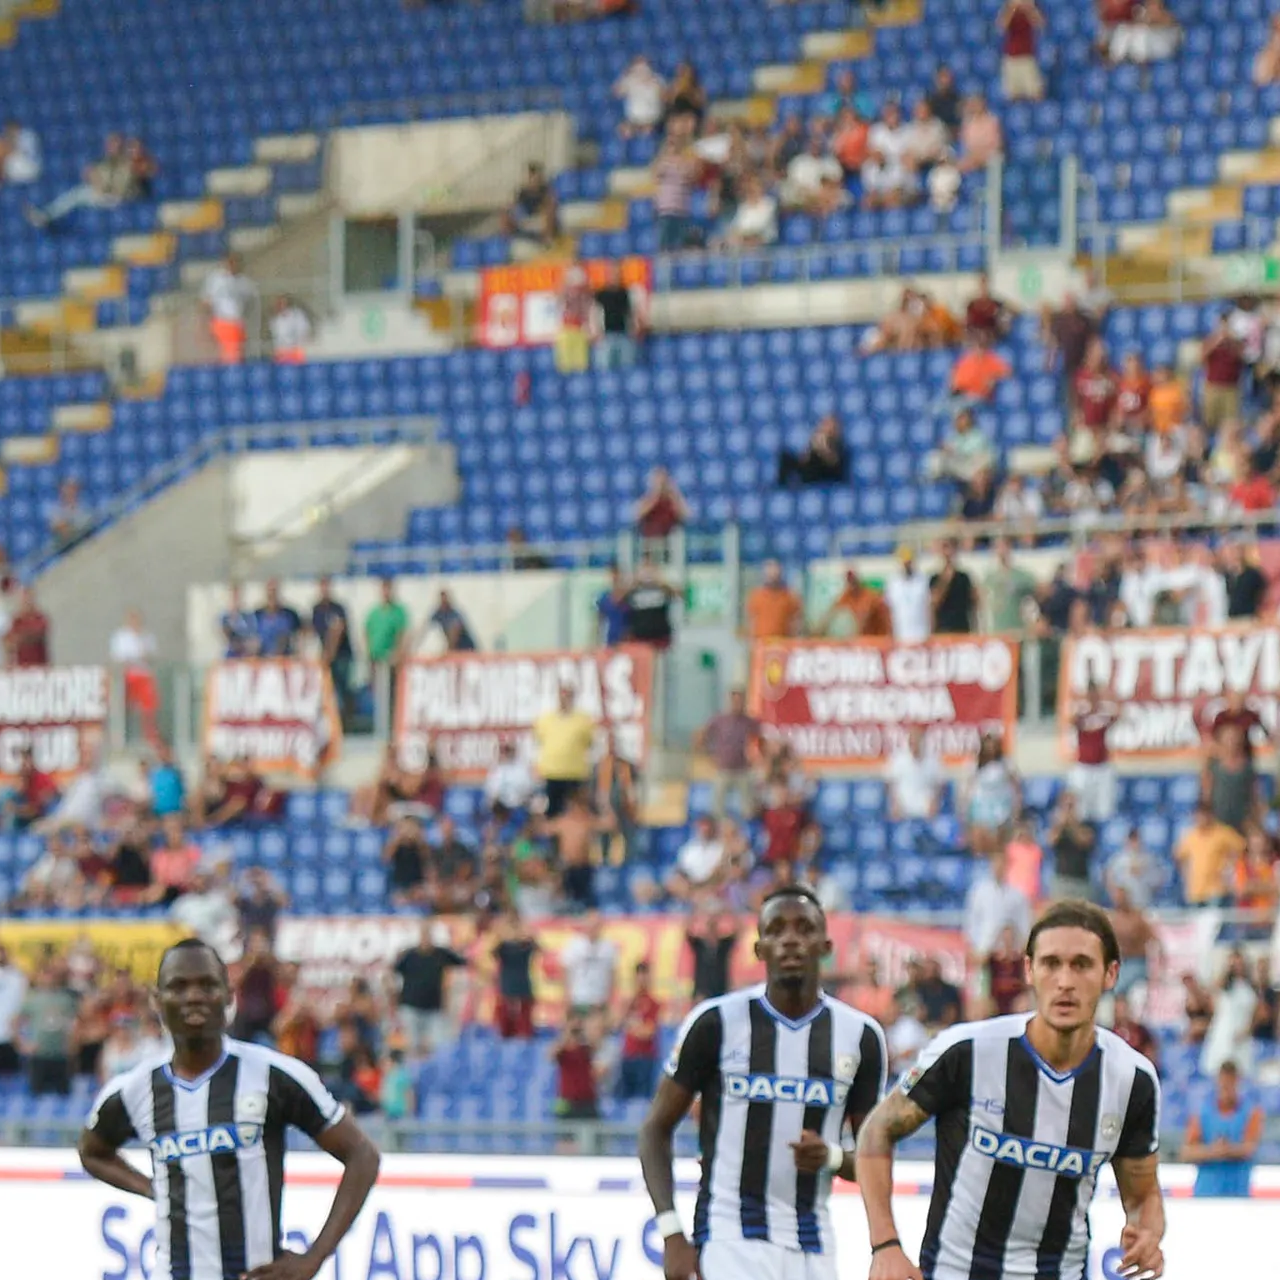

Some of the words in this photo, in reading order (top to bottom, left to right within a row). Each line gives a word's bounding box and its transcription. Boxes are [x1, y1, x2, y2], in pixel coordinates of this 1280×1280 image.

[786, 647, 883, 684] ROMA
[807, 685, 956, 722] VERONA
[729, 1076, 829, 1102] DACIA
[974, 1127, 1084, 1176] DACIA
